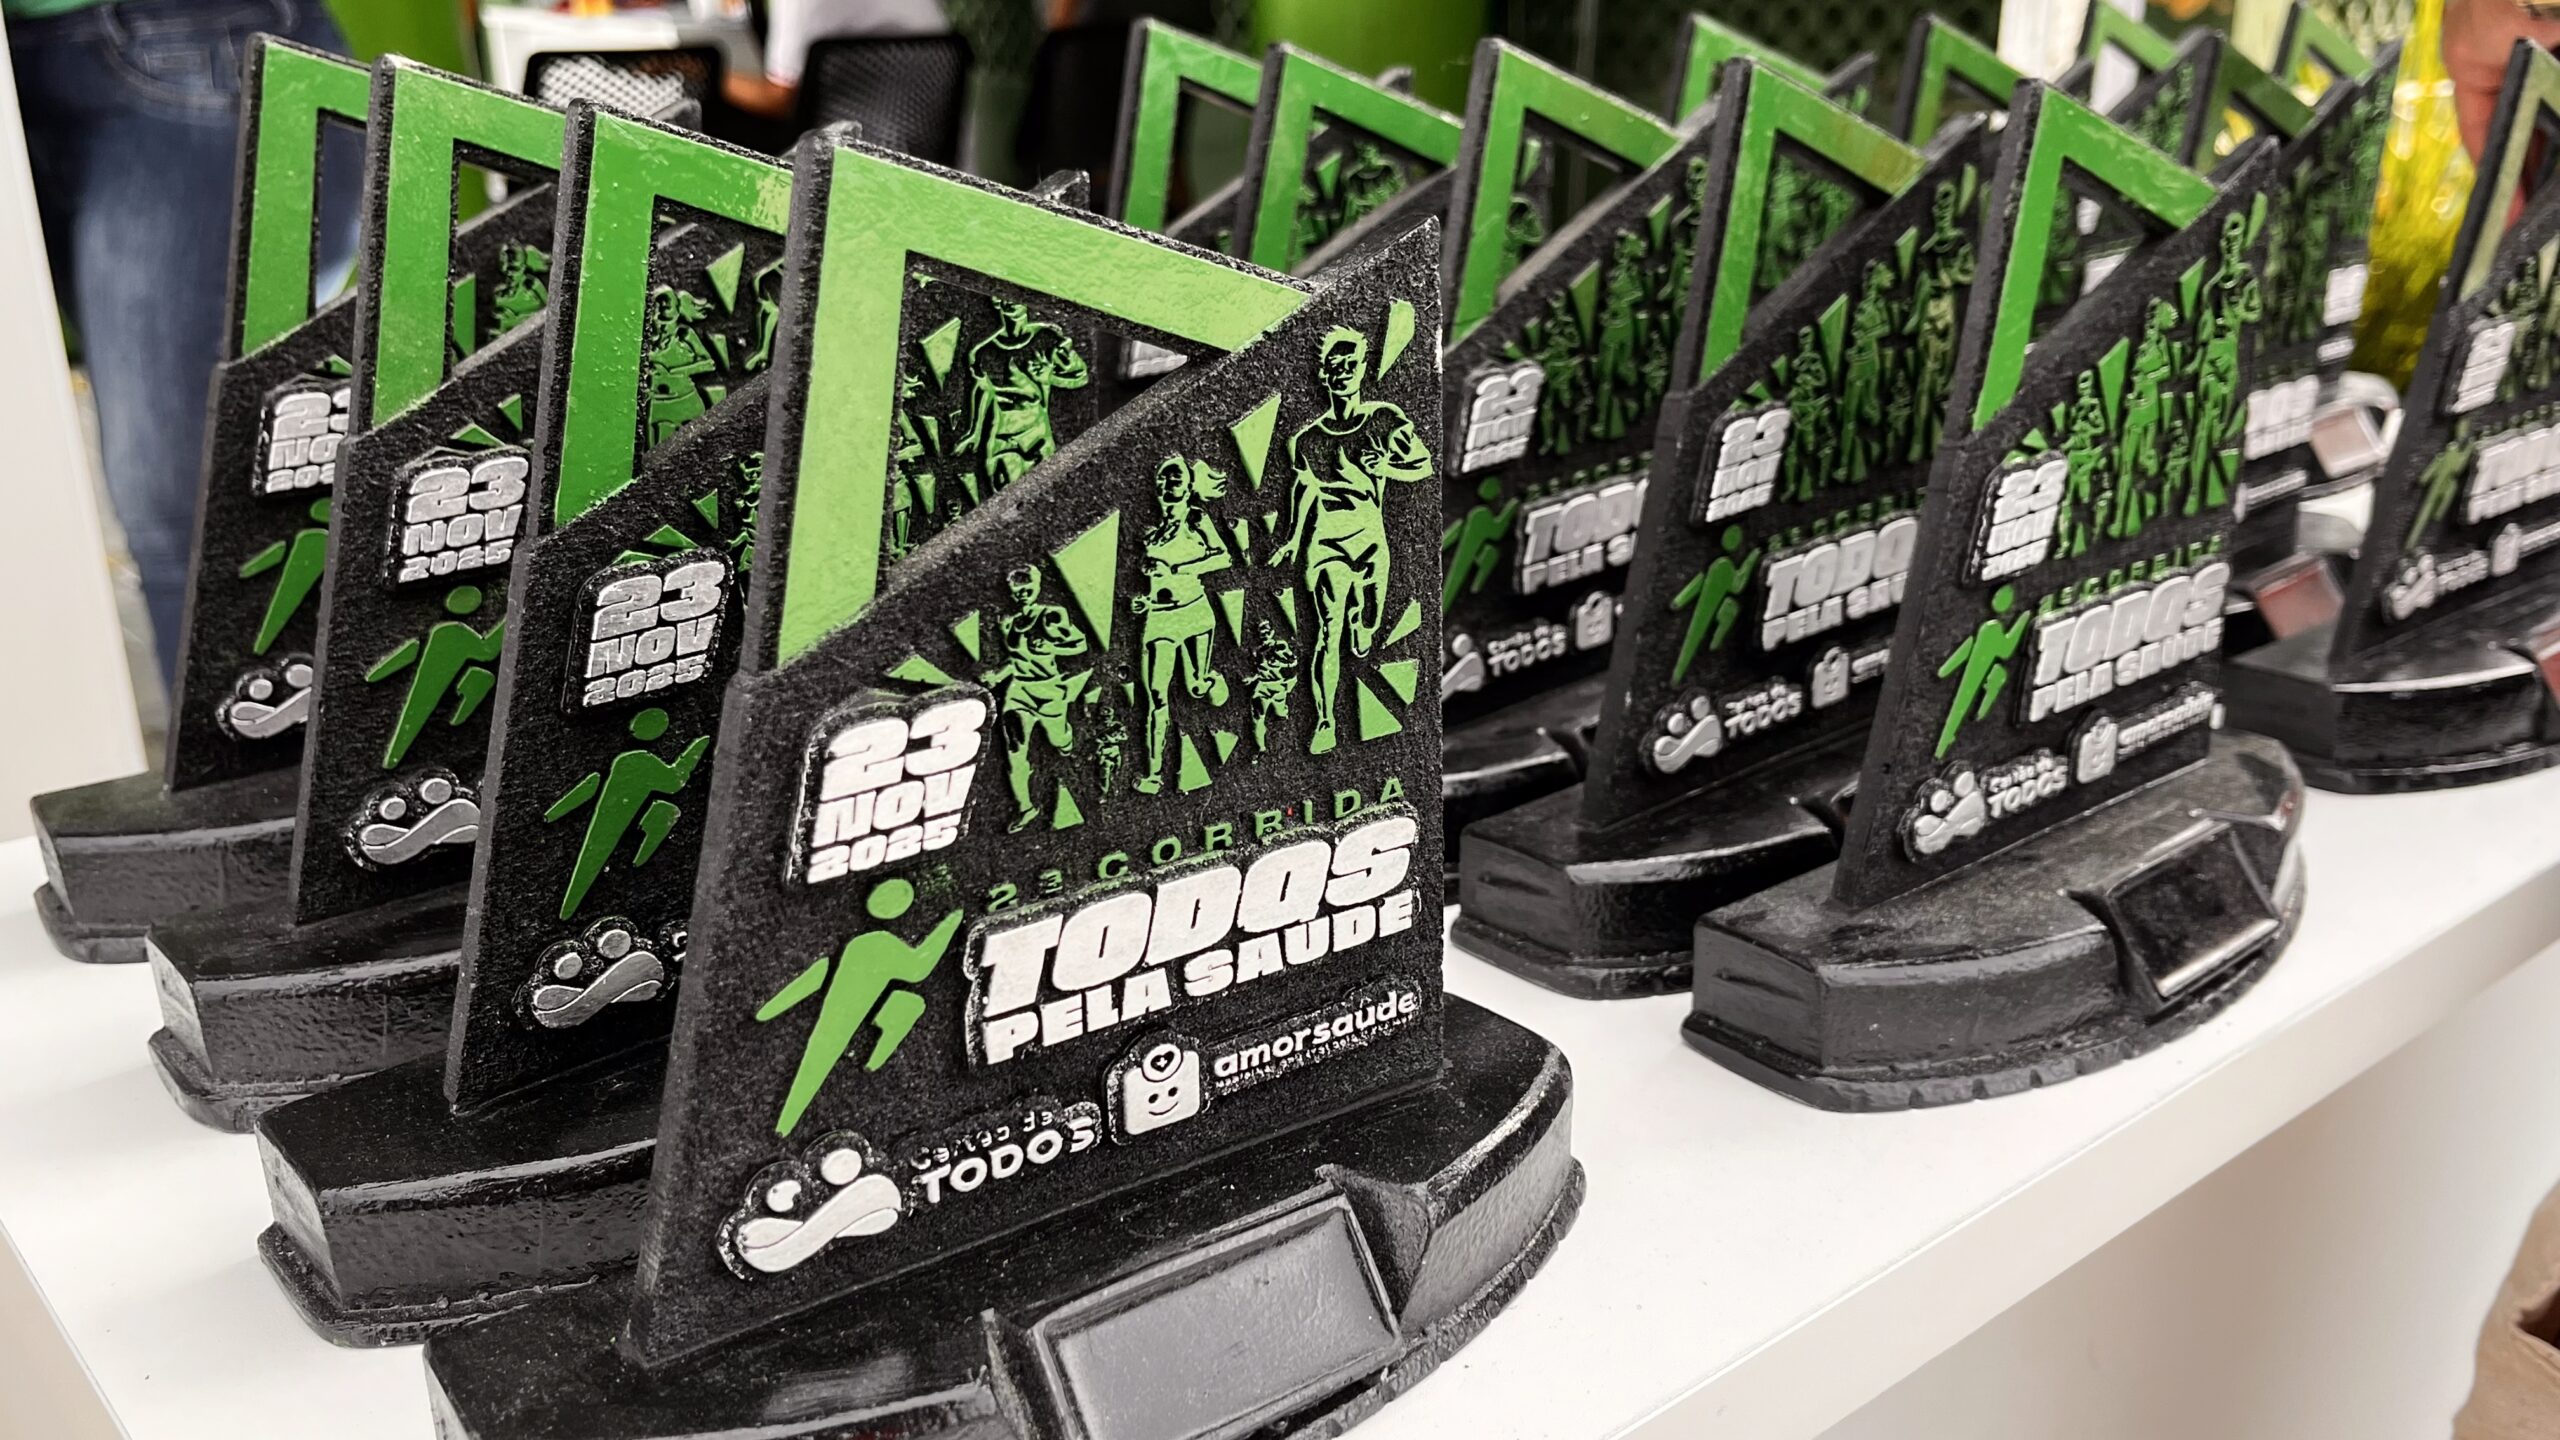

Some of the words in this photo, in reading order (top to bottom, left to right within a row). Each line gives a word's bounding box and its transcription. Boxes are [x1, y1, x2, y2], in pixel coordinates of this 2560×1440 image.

[268, 432, 346, 471] NO
[406, 457, 529, 524] 23
[399, 539, 514, 583] 2025
[402, 504, 523, 556] NOV
[591, 561, 725, 640] 23
[582, 654, 707, 708] 2025
[584, 614, 717, 678] NOV
[819, 698, 988, 801] 23
[811, 763, 976, 848] NOV
[1098, 777, 1404, 880] CORRIDA
[807, 813, 961, 884] 2025
[982, 816, 1417, 1018] TODOS
[983, 968, 1172, 1065] PELA
[912, 1116, 1095, 1204] TODOS
